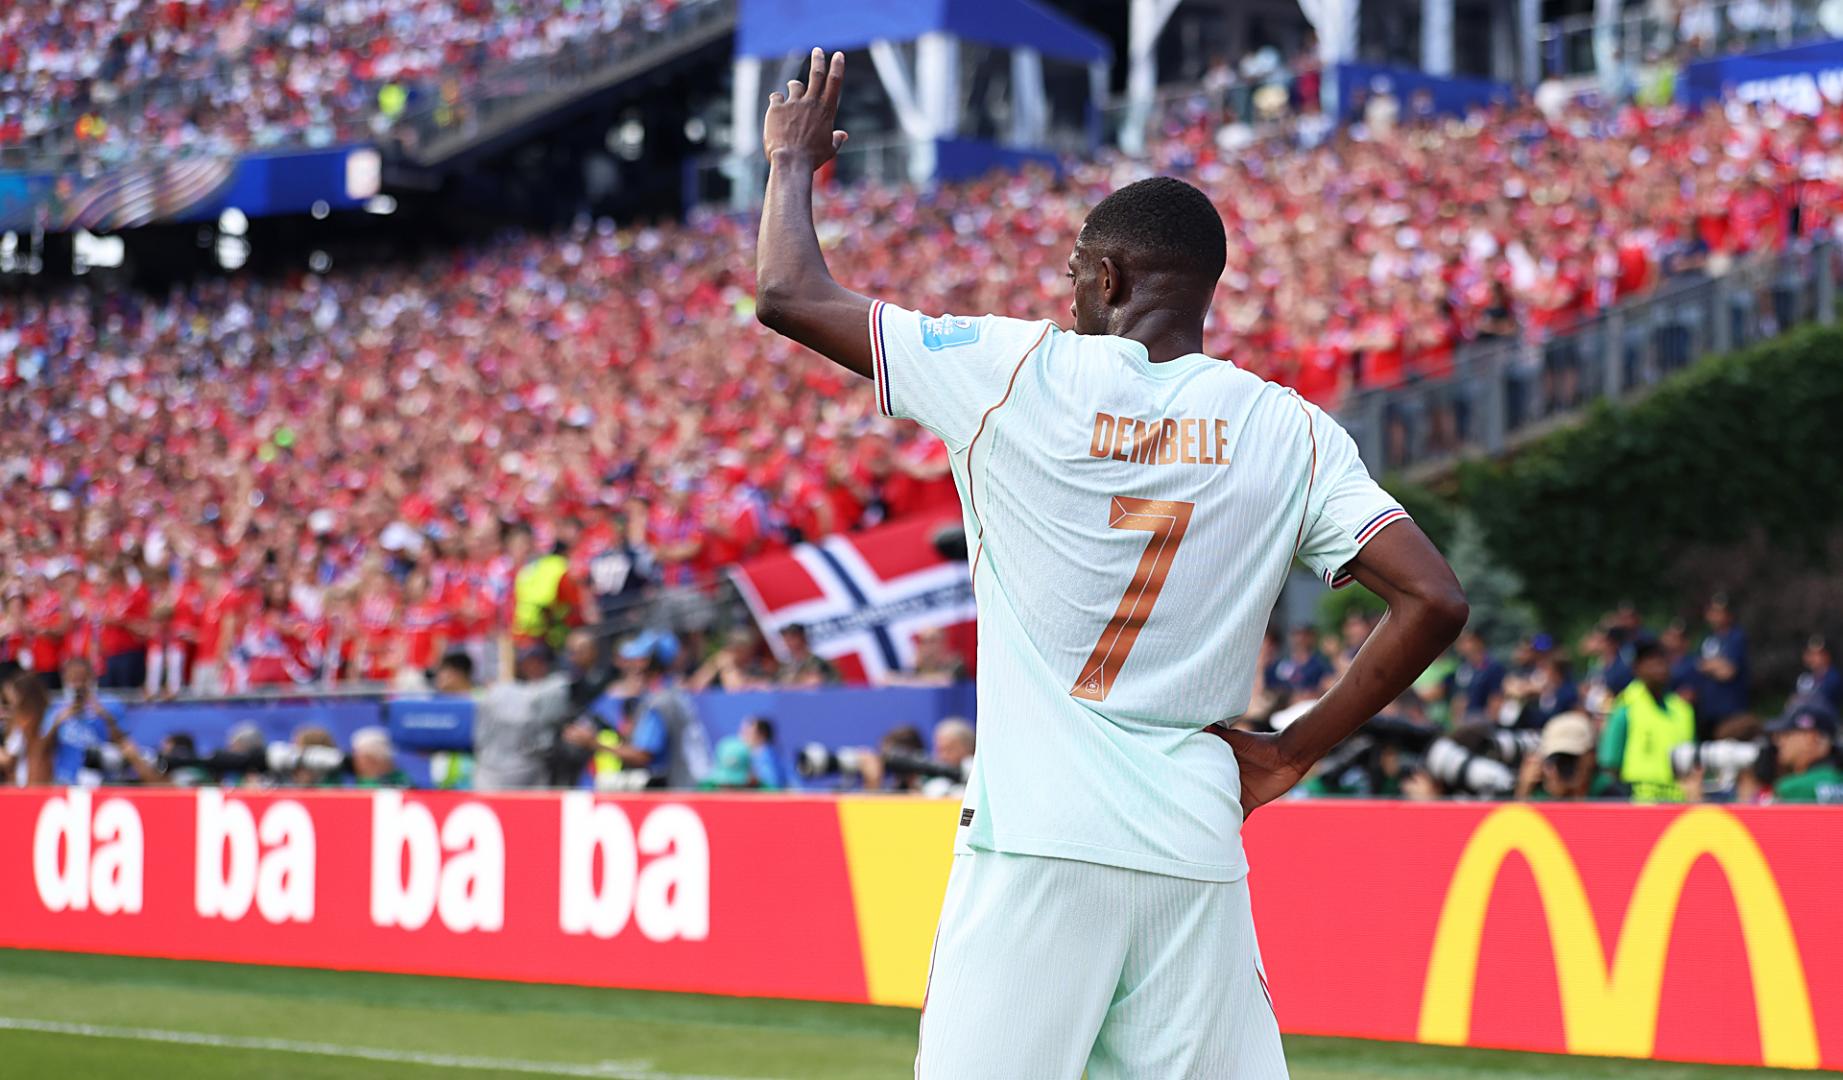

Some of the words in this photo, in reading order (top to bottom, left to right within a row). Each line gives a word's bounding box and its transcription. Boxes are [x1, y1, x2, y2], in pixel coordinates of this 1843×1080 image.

[1089, 412, 1231, 465] DEMBELE
[1069, 495, 1195, 702] 7
[34, 786, 144, 914] da
[195, 787, 316, 923] ba
[371, 788, 505, 933] ba
[559, 790, 710, 942] ba
